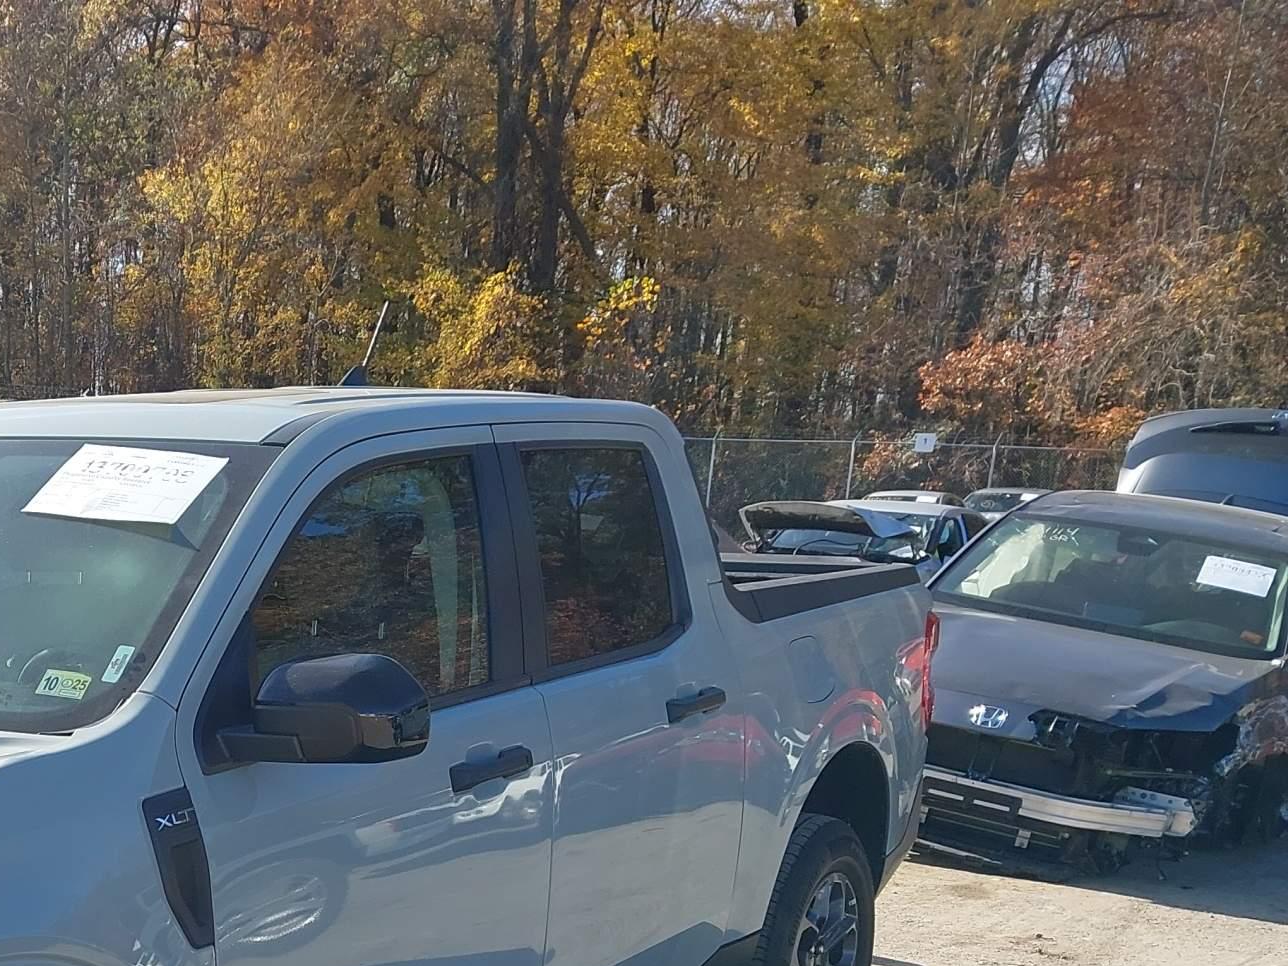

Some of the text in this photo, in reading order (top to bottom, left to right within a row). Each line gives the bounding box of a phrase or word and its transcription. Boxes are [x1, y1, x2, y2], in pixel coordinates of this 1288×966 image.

[43, 675, 88, 691] 10 25
[155, 807, 195, 831] XLT
